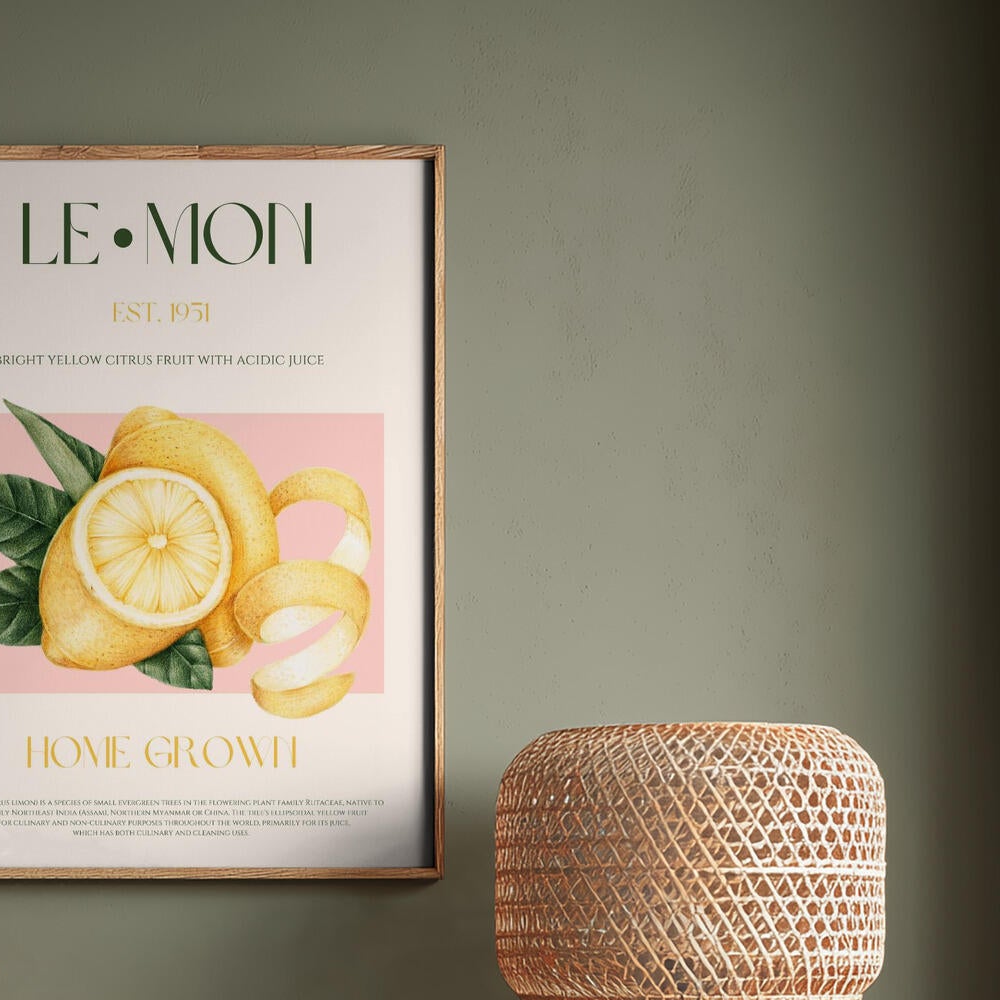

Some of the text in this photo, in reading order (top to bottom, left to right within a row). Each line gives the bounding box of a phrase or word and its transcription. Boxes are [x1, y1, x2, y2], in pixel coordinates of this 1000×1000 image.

[113, 302, 210, 323] EST. 1951
[48, 354, 102, 366] YELLOW
[105, 354, 153, 366] CITRUS
[157, 354, 195, 366] FRUIT
[198, 354, 233, 366] WITH
[237, 354, 286, 366] ACIDIC
[288, 354, 325, 368] JUICE
[27, 735, 297, 769] HOME GROWN
